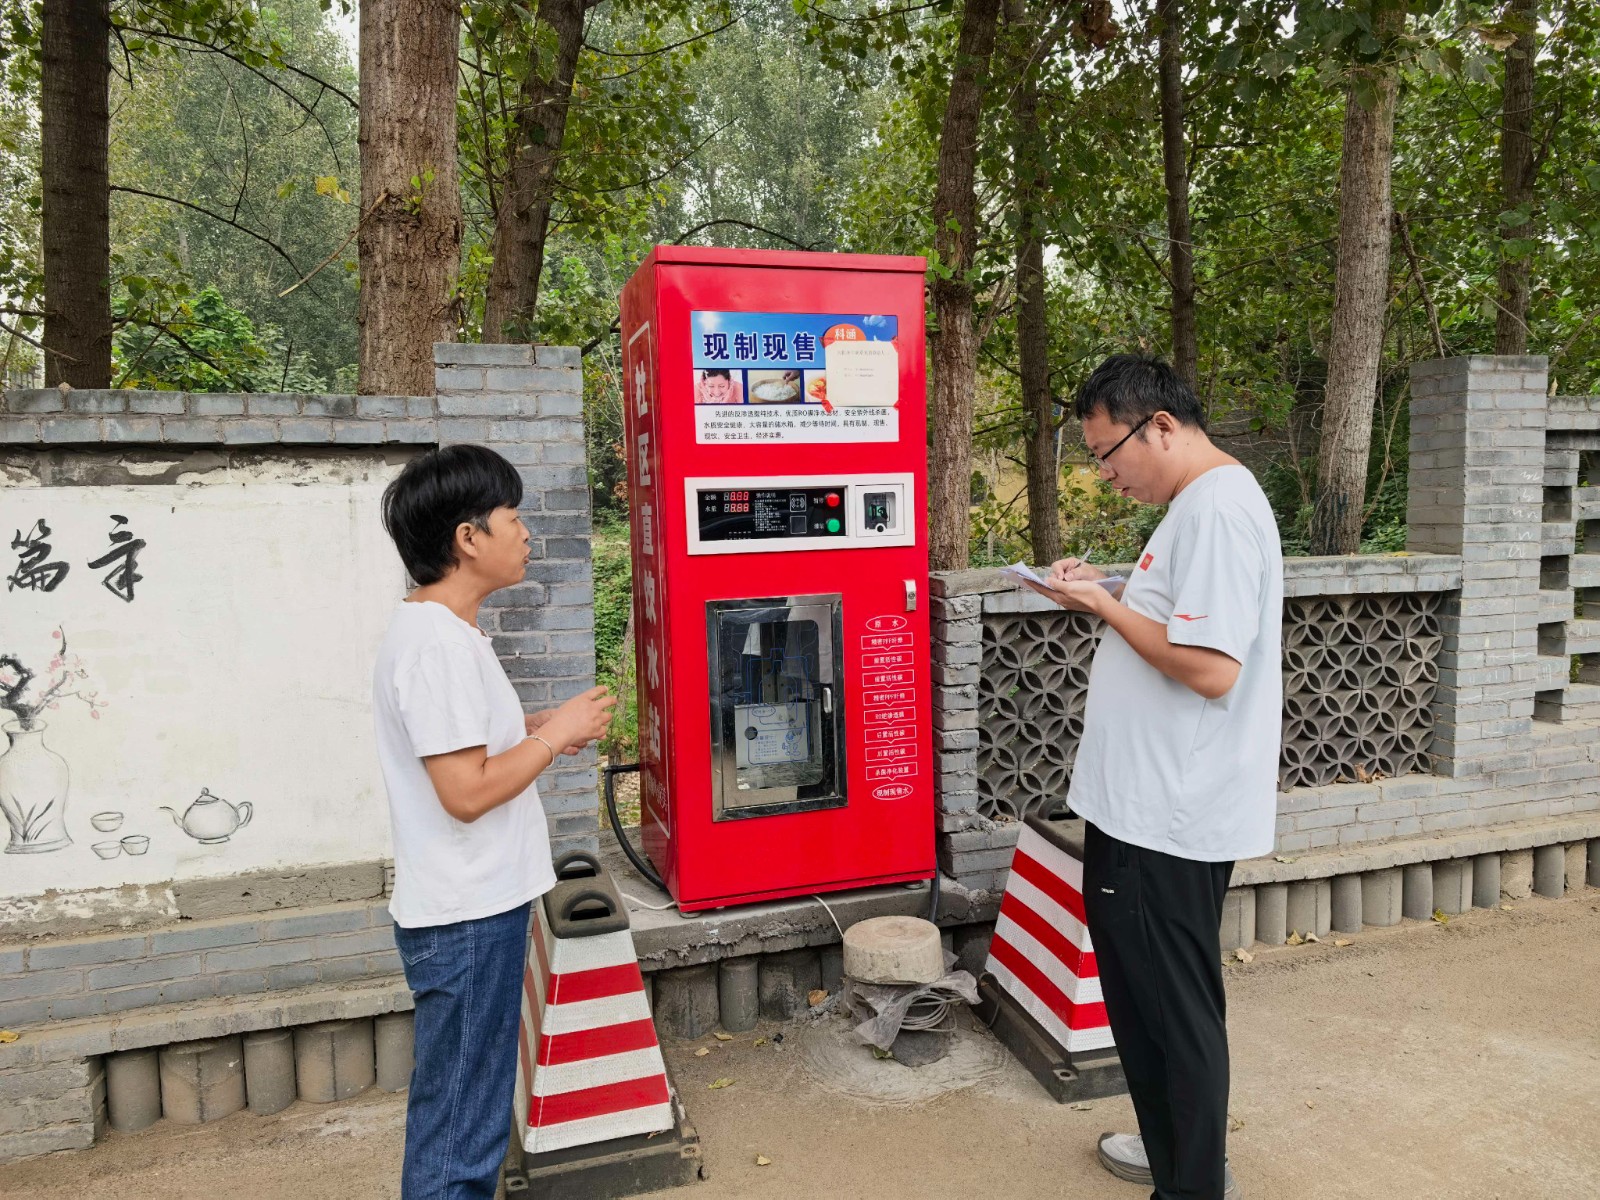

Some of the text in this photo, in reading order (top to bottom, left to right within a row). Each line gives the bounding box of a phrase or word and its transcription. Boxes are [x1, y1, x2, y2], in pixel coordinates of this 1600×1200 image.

[703, 332, 816, 361] 现制现售
[634, 360, 661, 762] 社区直饮水站
